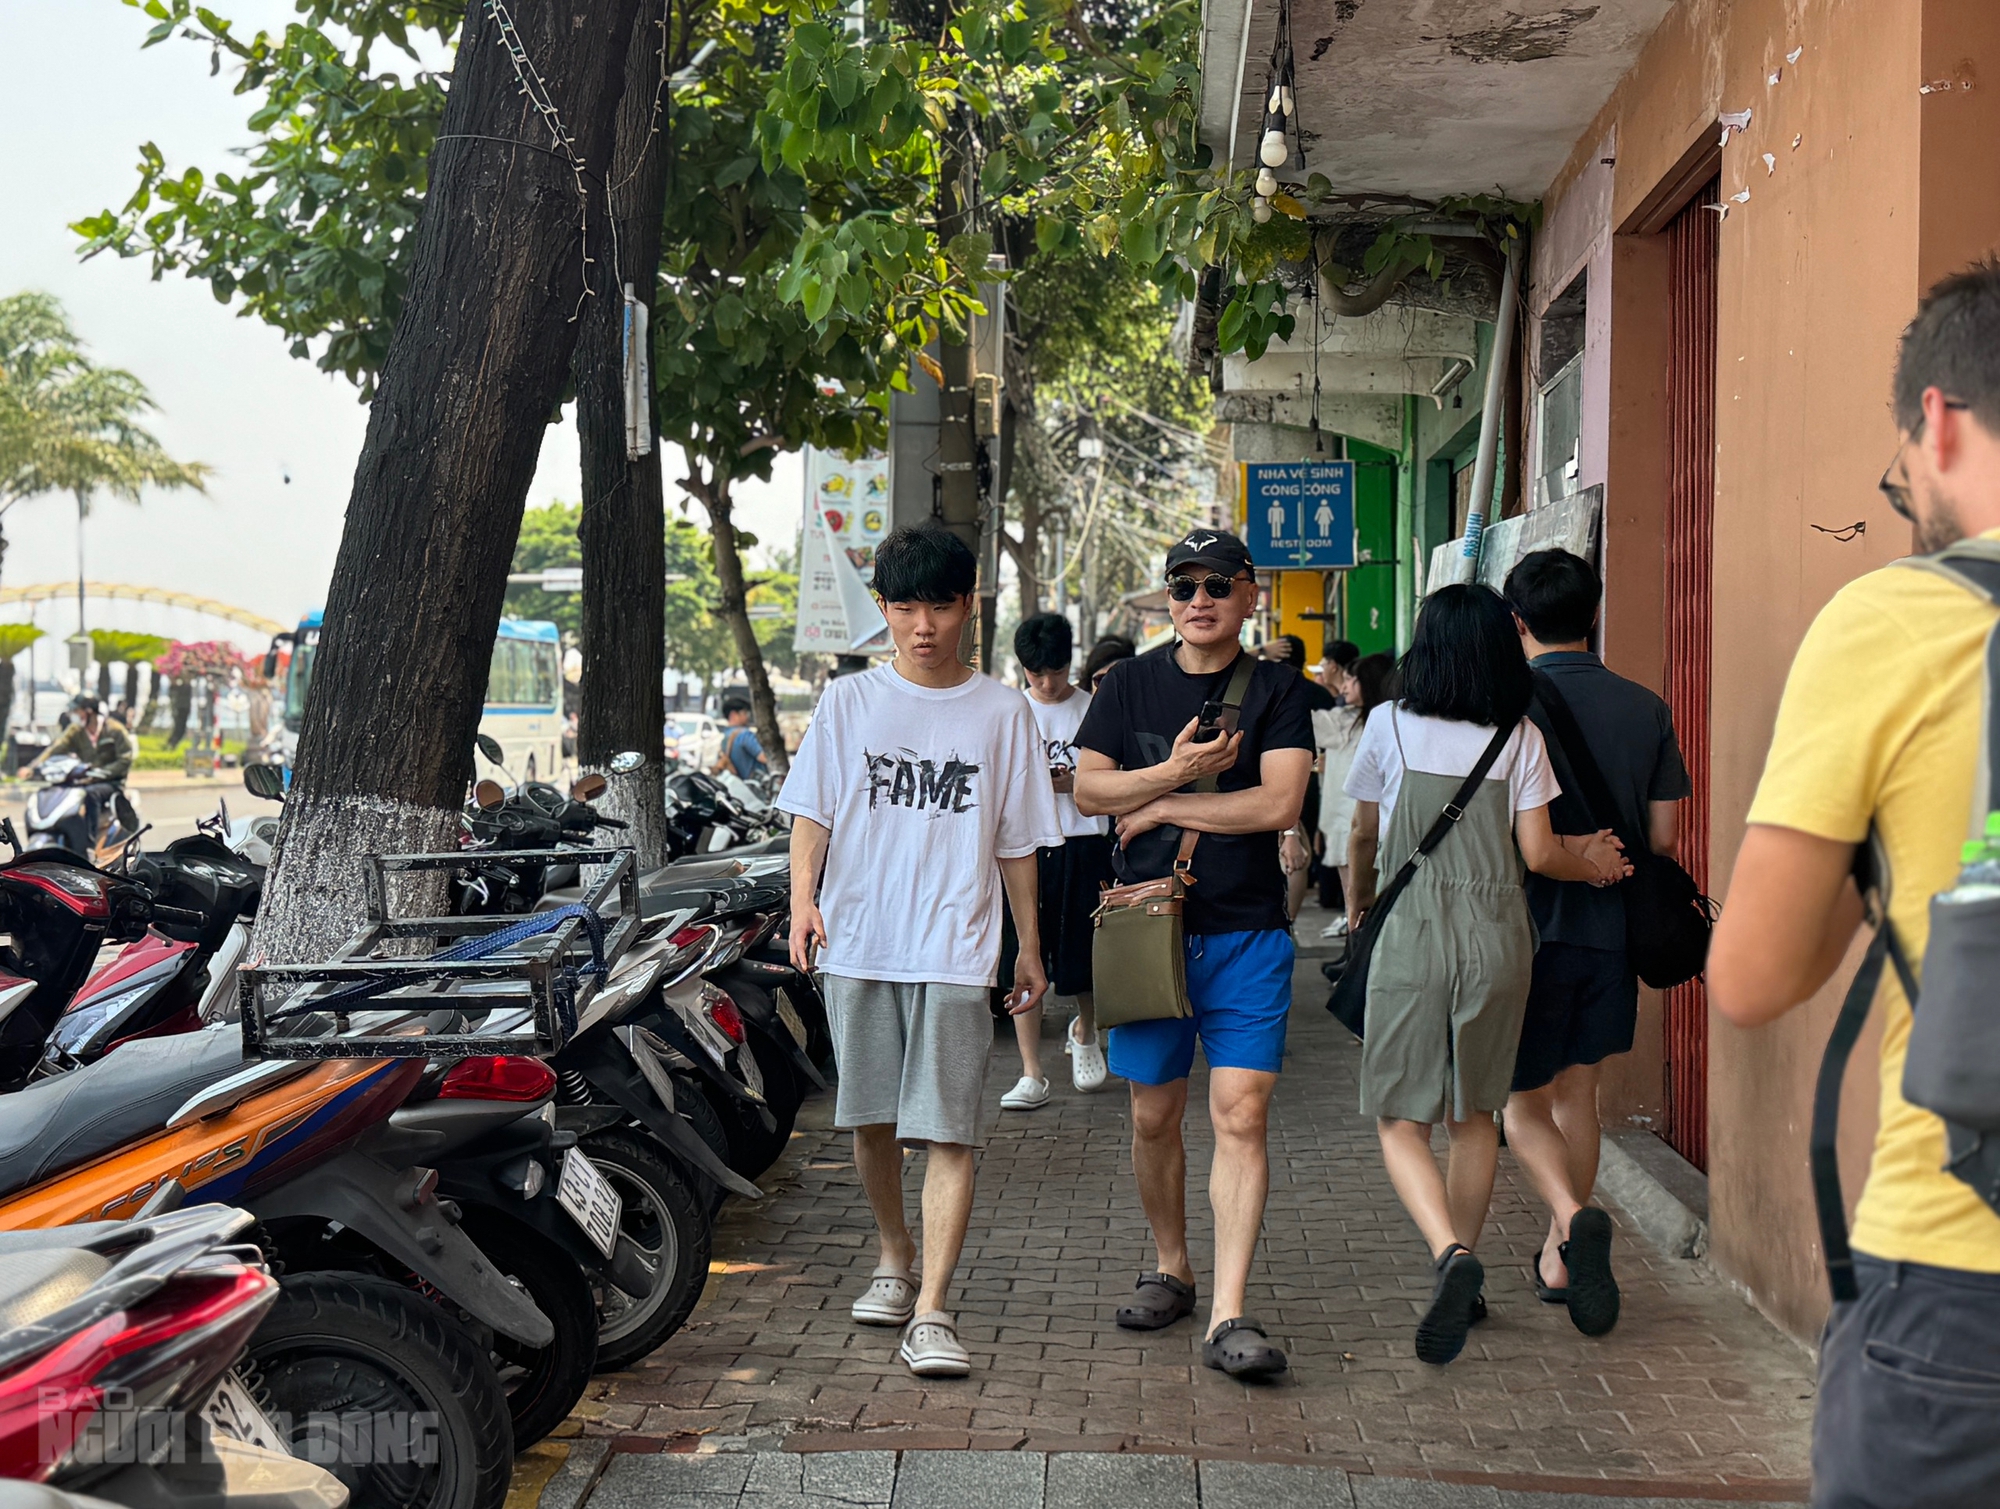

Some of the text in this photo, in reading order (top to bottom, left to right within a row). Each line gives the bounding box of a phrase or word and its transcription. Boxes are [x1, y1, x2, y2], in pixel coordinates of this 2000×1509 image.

[1310, 467, 1343, 479] SINH
[1261, 482, 1341, 496] CÔNG CỘNG
[1271, 539, 1332, 548] RESTOOM
[863, 748, 980, 814] FAME
[586, 1177, 617, 1250] 708.32
